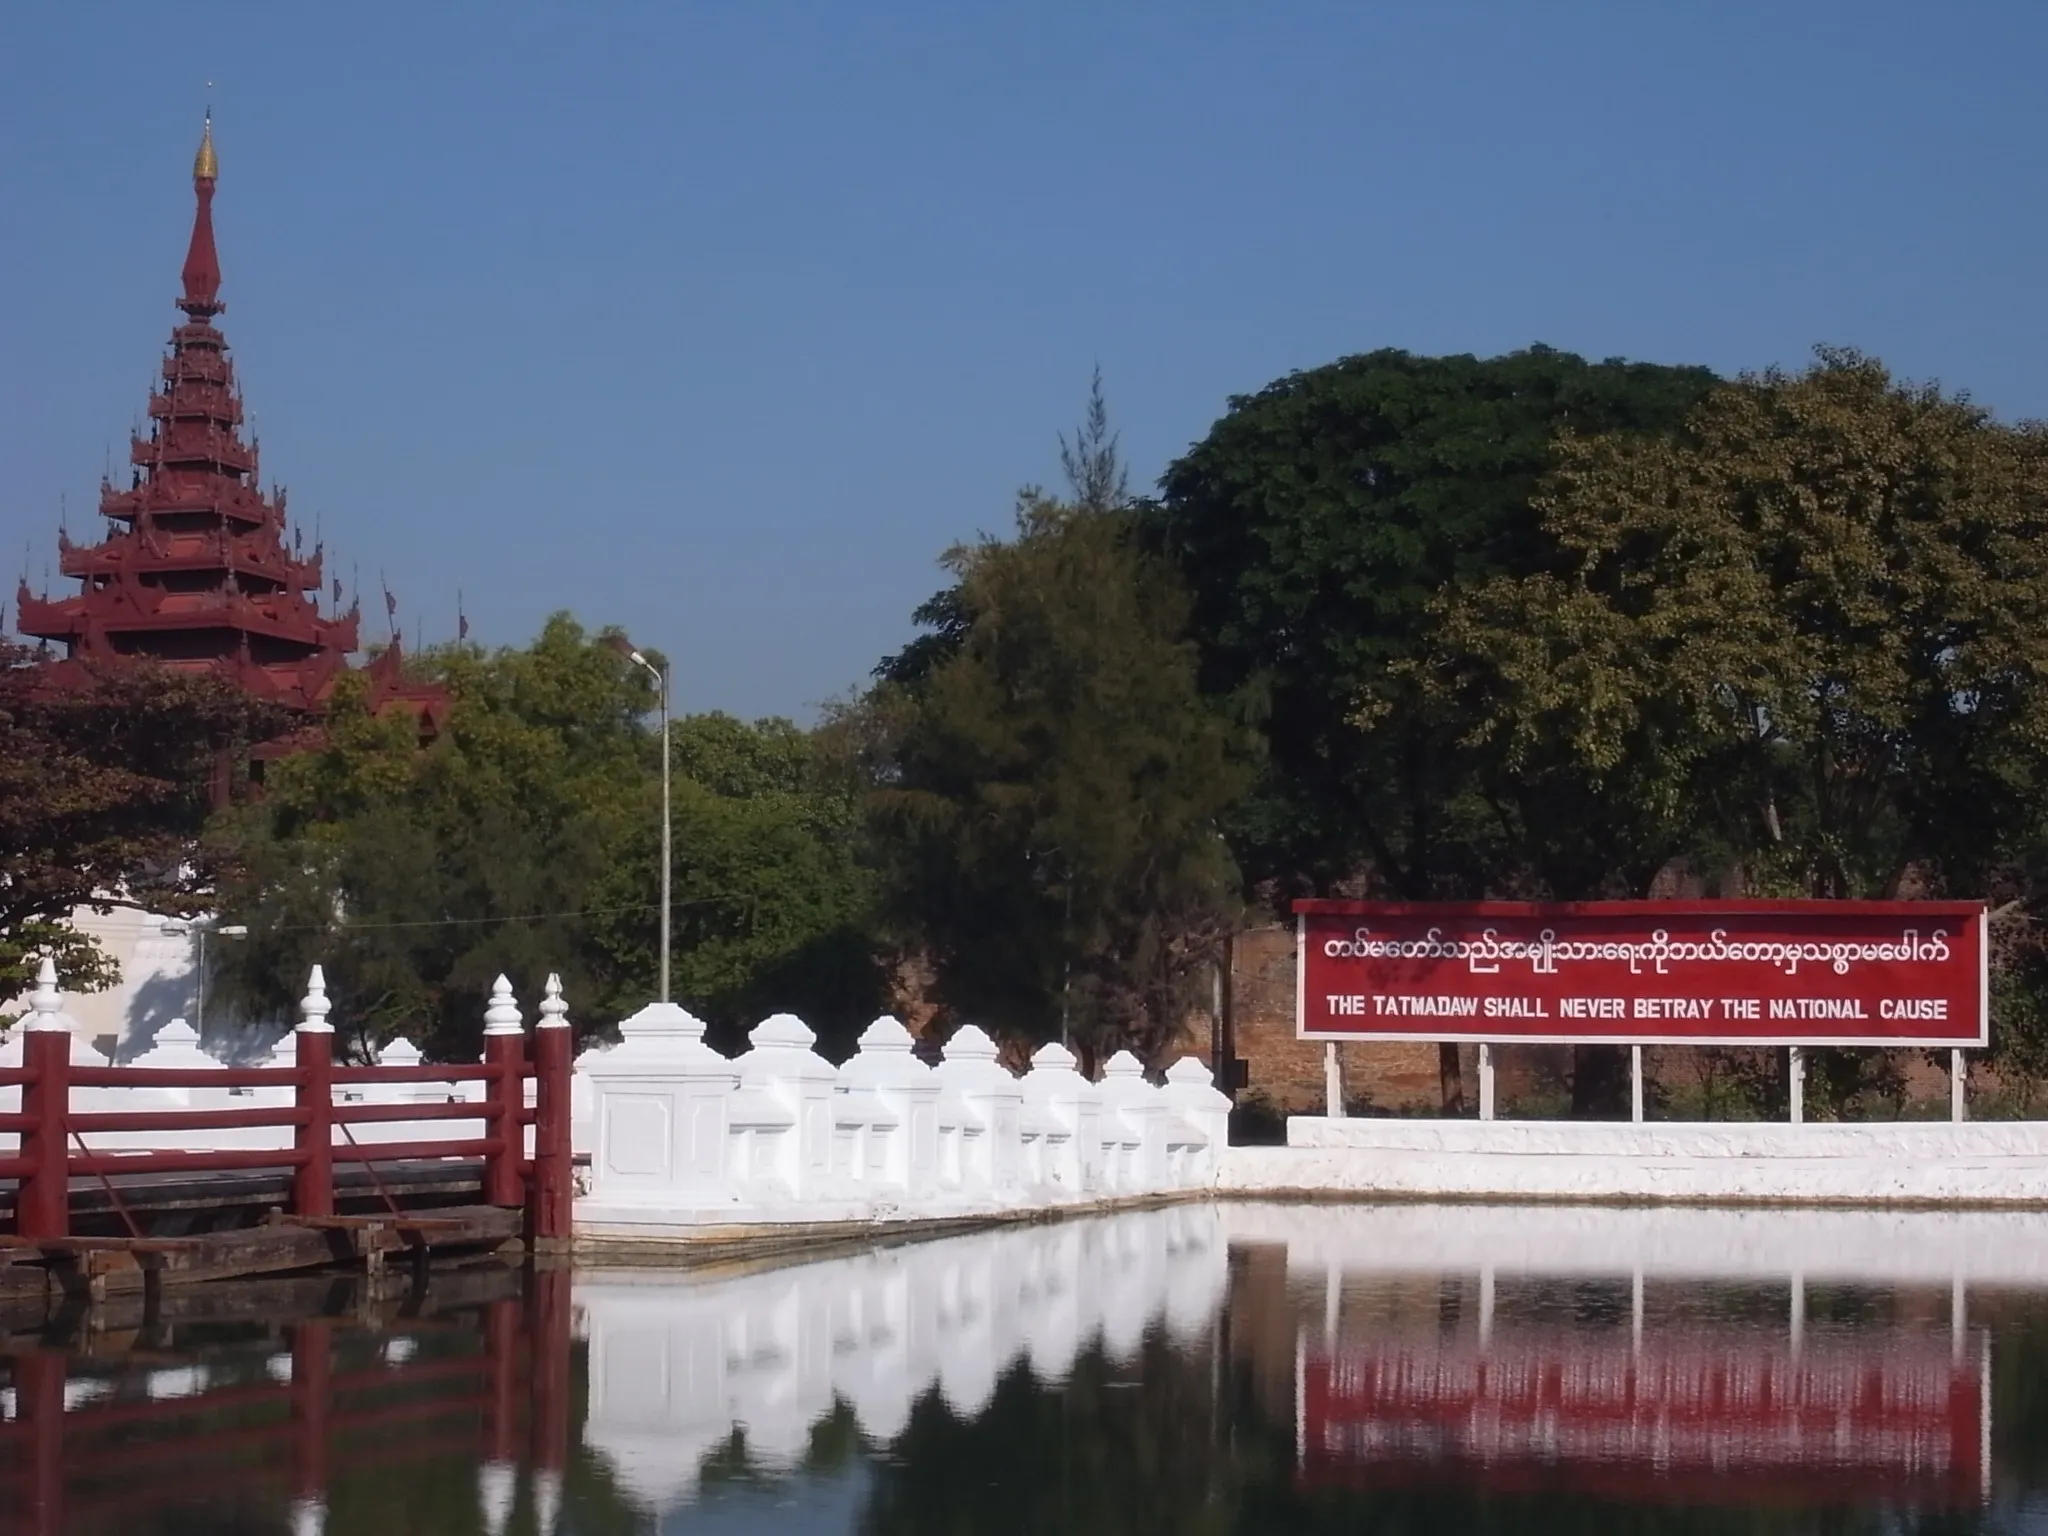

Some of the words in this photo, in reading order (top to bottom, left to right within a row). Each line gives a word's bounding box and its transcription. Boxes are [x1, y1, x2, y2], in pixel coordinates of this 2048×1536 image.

[1326, 995, 1366, 1016] THE
[1373, 995, 1478, 1017] TATMADAW
[1484, 996, 1549, 1018] SHALL
[1560, 998, 1626, 1019] NEVER
[1634, 998, 1713, 1019] BETRAY
[1721, 998, 1761, 1019] THE
[1770, 998, 1868, 1019] NATIONAL
[1879, 998, 1948, 1020] CAUSE
